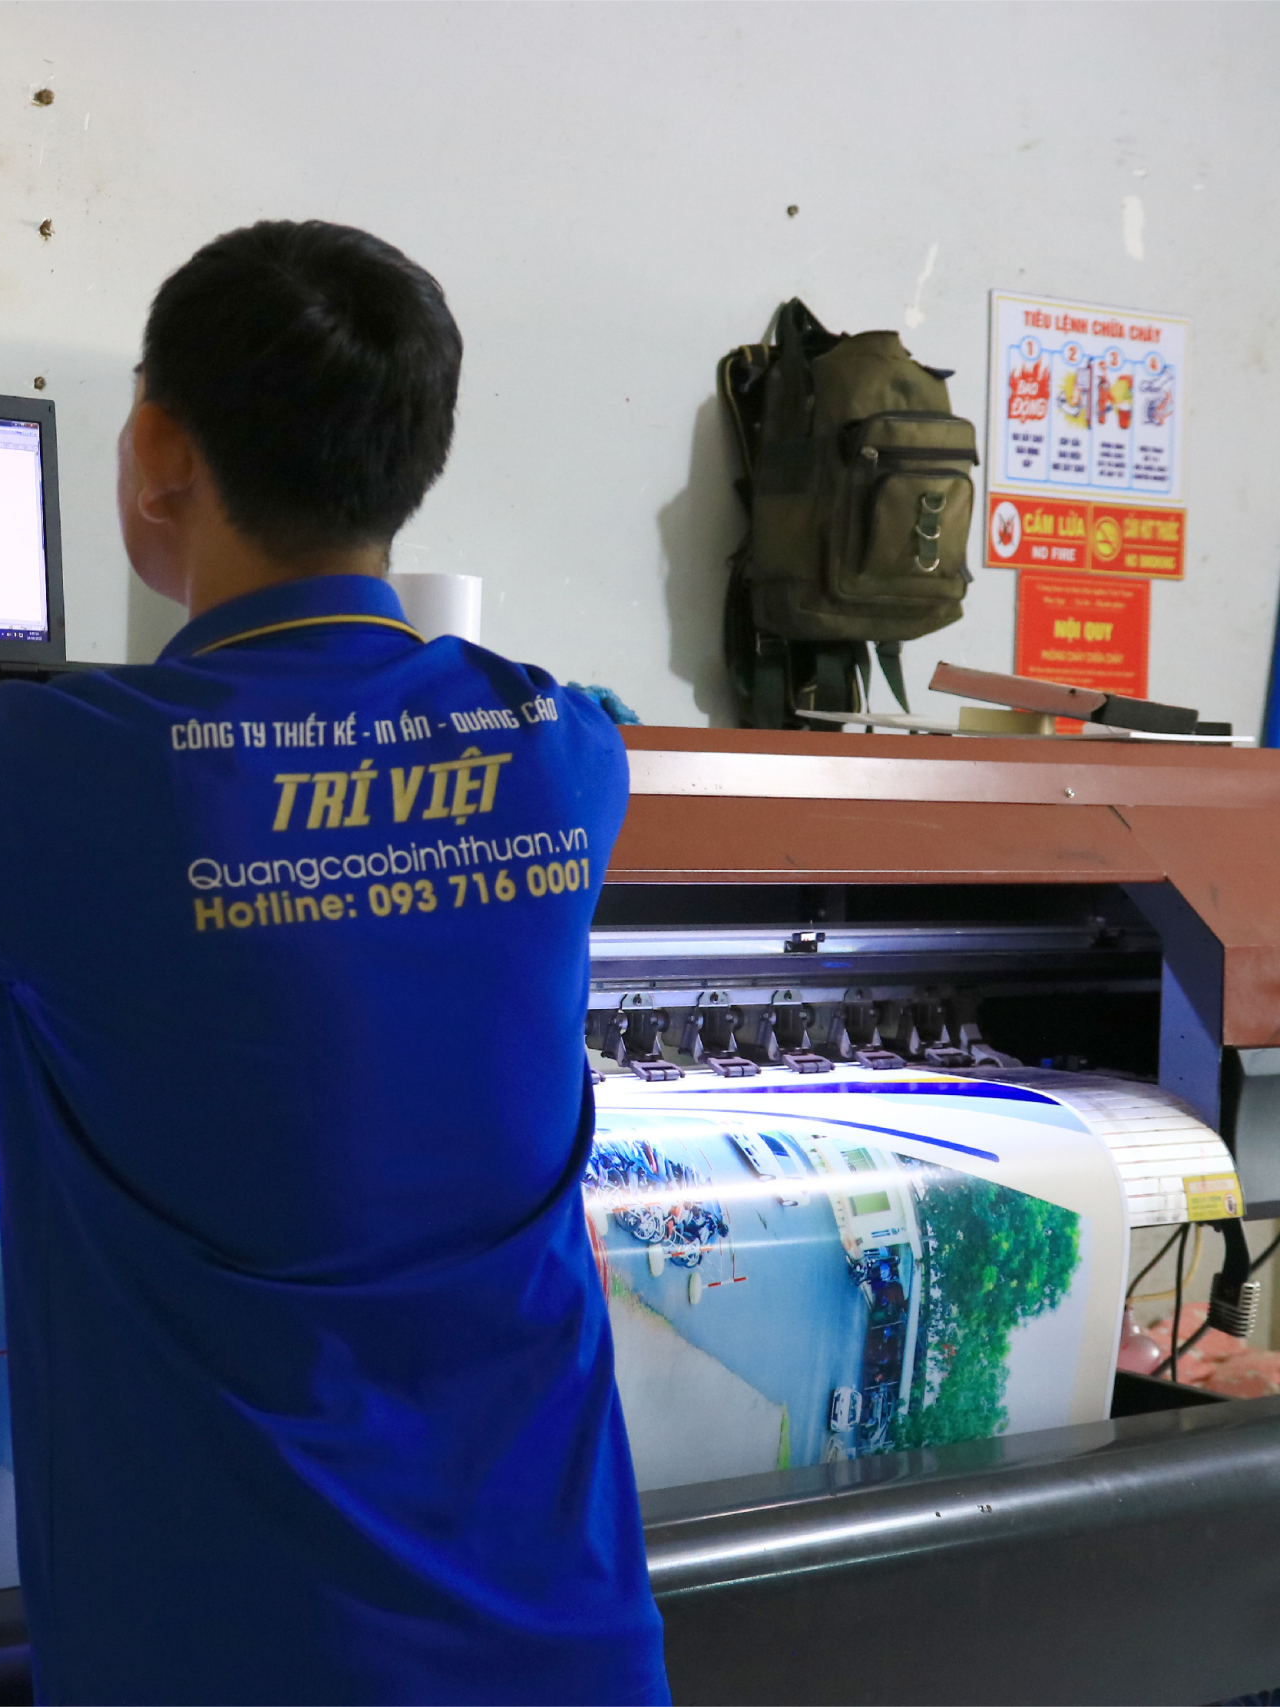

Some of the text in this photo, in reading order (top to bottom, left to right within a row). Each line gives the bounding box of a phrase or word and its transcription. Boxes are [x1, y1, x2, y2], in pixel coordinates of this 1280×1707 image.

[1026, 341, 1034, 357] 1
[1068, 346, 1078, 362] 2
[1110, 351, 1120, 366] 3
[1023, 508, 1054, 534] CẤM
[1031, 546, 1077, 561] NO FIRE
[171, 718, 235, 751] CÔNG
[240, 721, 266, 748] TY
[272, 712, 327, 748] THIẾT
[333, 711, 357, 746] KẾ
[374, 719, 397, 745] IN
[400, 709, 431, 742] ẤN
[521, 694, 559, 724] CÁO
[272, 746, 513, 832] TRÍ VIỆT
[188, 827, 588, 890] Quangcaobinhthuan.vn
[194, 858, 590, 931] Hotline: 093 716 0001
